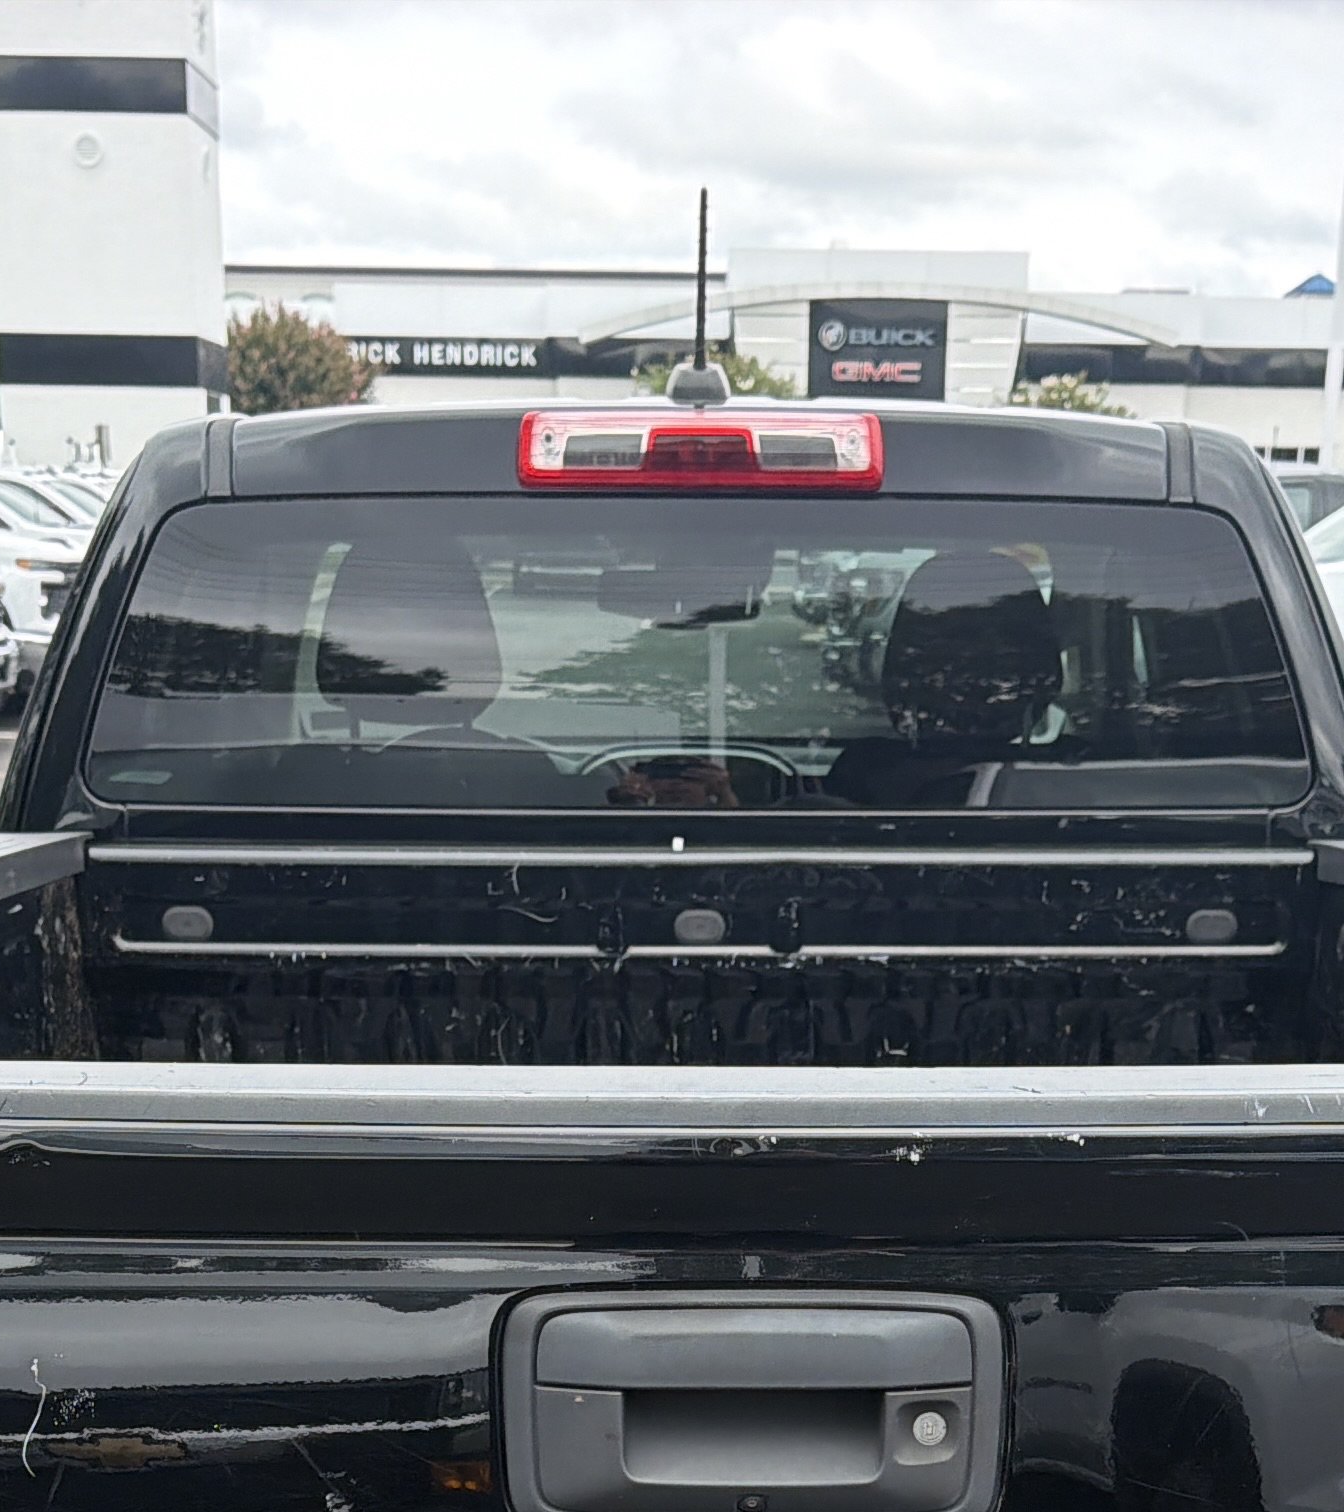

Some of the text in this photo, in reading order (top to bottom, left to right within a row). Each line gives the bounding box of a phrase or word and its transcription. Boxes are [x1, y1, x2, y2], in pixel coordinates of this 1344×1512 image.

[848, 327, 936, 346] BUICK
[413, 340, 538, 367] HENDRICK
[831, 360, 923, 383] GMC
